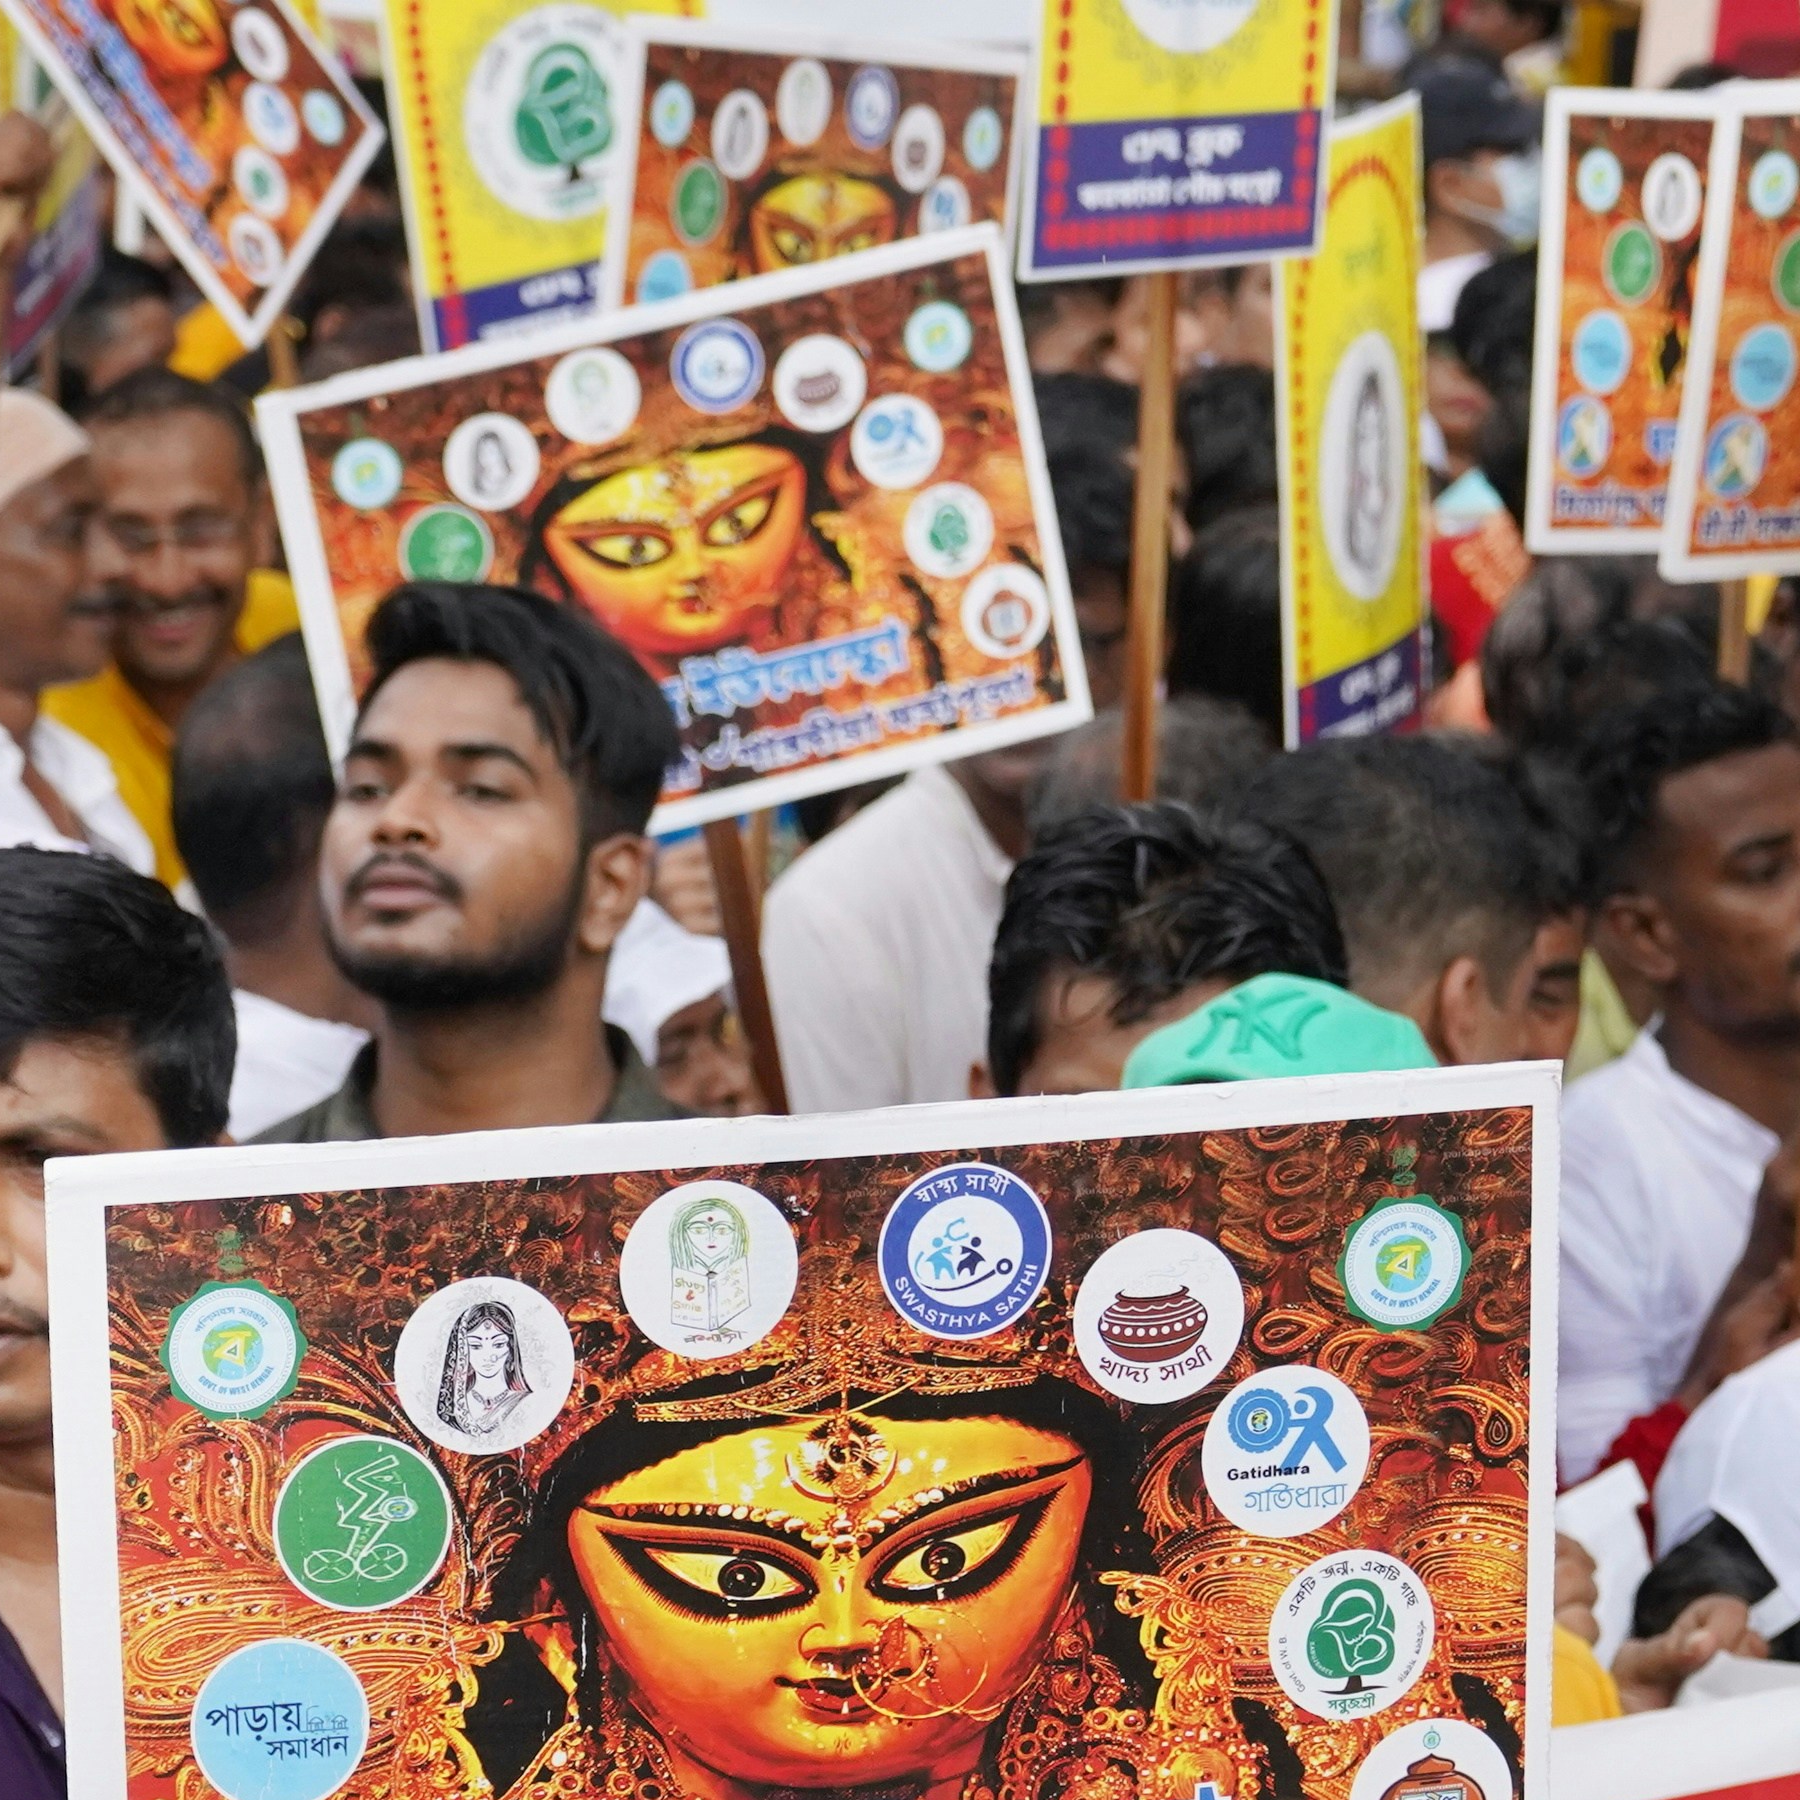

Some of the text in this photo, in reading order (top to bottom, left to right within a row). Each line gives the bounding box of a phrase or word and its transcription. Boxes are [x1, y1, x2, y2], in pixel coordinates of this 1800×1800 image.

[965, 1171, 1012, 1196] সাথী
[895, 1263, 1039, 1328] SWASTHYA SATHI
[1099, 1344, 1213, 1384] খাদ্য সাথী
[1227, 1464, 1310, 1481] Gatidhara
[1244, 1482, 1348, 1513] গতিধারা
[1289, 1576, 1317, 1617] একটি
[1360, 1560, 1401, 1582] একটি
[1400, 1582, 1420, 1609] গাছ
[1327, 1693, 1376, 1715] সবুজশ্রী
[205, 1700, 303, 1742] পাড়ায়
[265, 1734, 350, 1761] সমাধান
